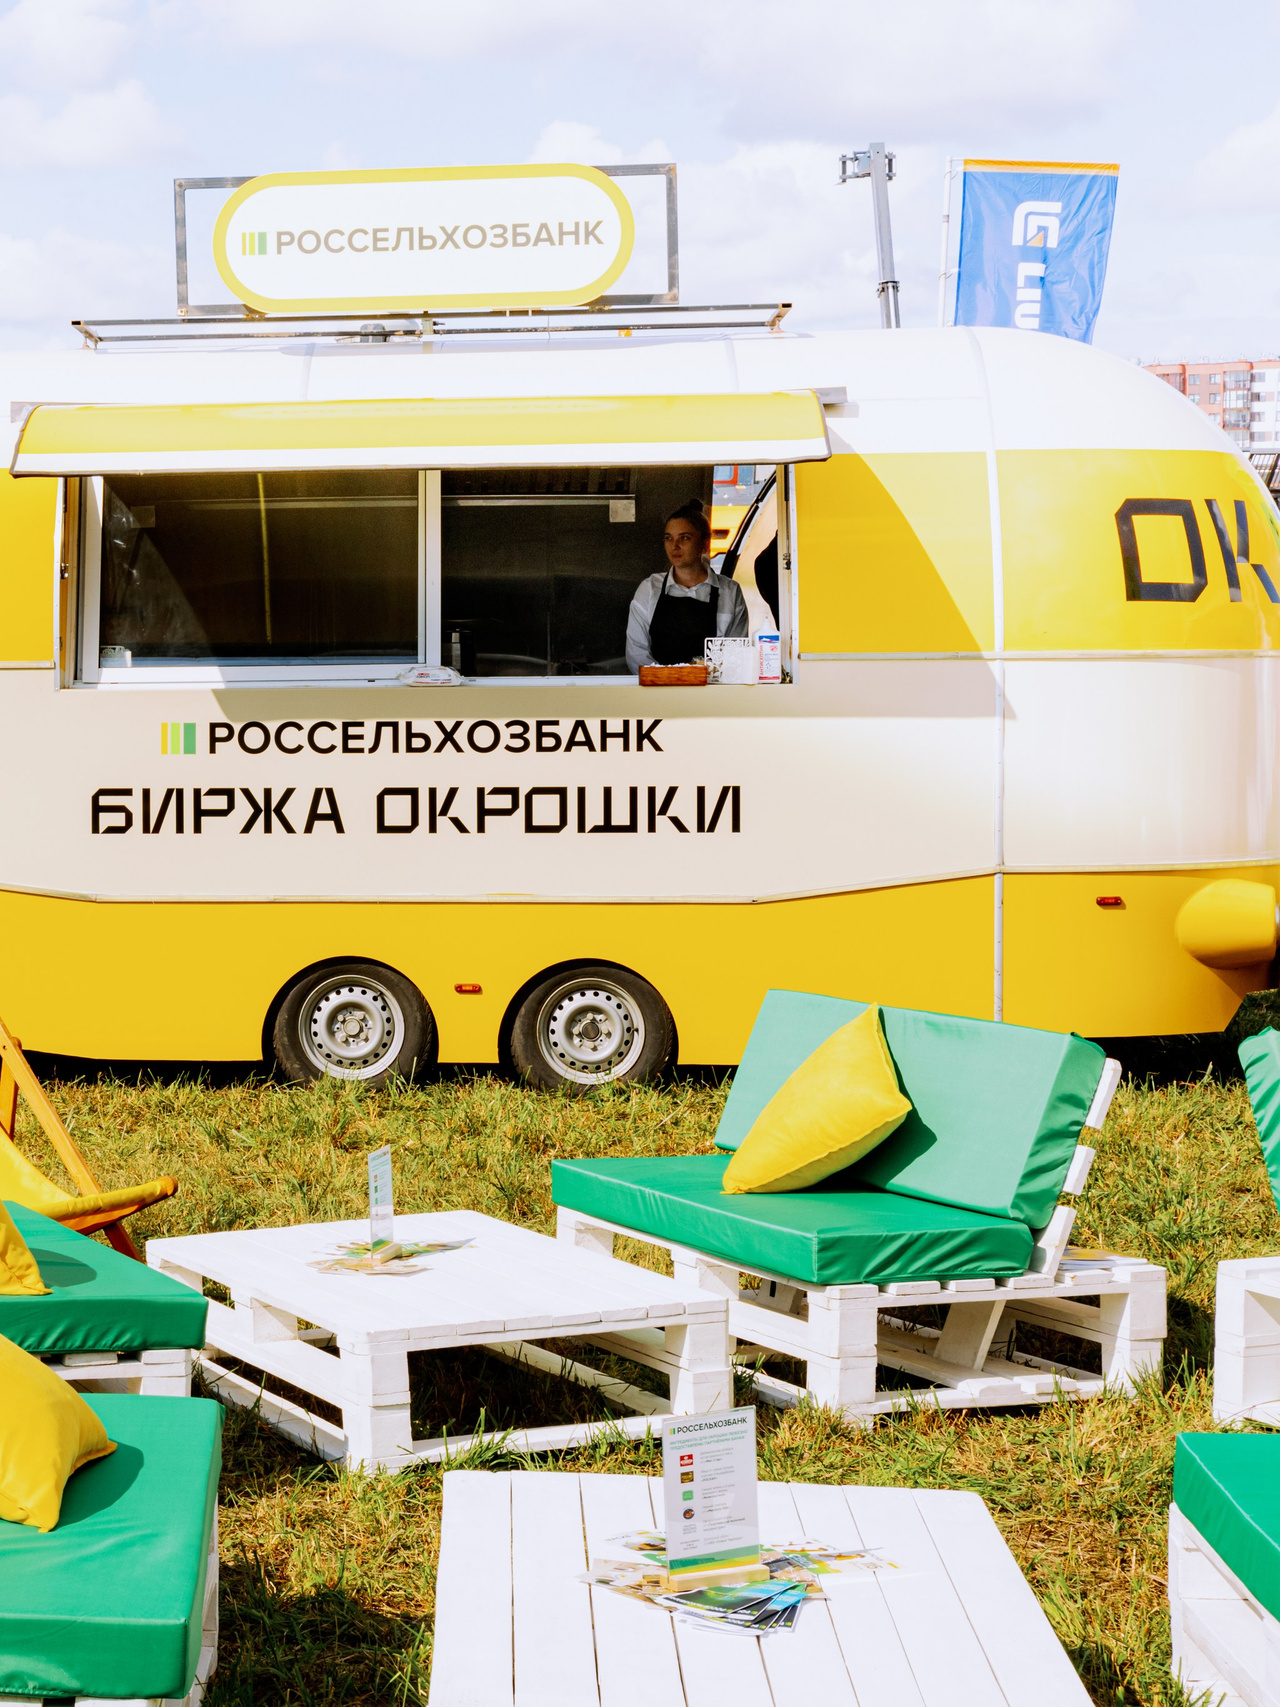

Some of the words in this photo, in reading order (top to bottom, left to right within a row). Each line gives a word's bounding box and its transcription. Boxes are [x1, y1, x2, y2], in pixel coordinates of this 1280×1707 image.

[275, 220, 605, 255] РОССЕЛЬХОЗБАНК
[208, 718, 664, 755] РОССЕЛЬХОЗБАНК
[91, 786, 346, 834] БИРЖА
[376, 785, 741, 834] ОКРОШКИ
[677, 1417, 748, 1434] РОССЕЛЬХОЗБАНК
